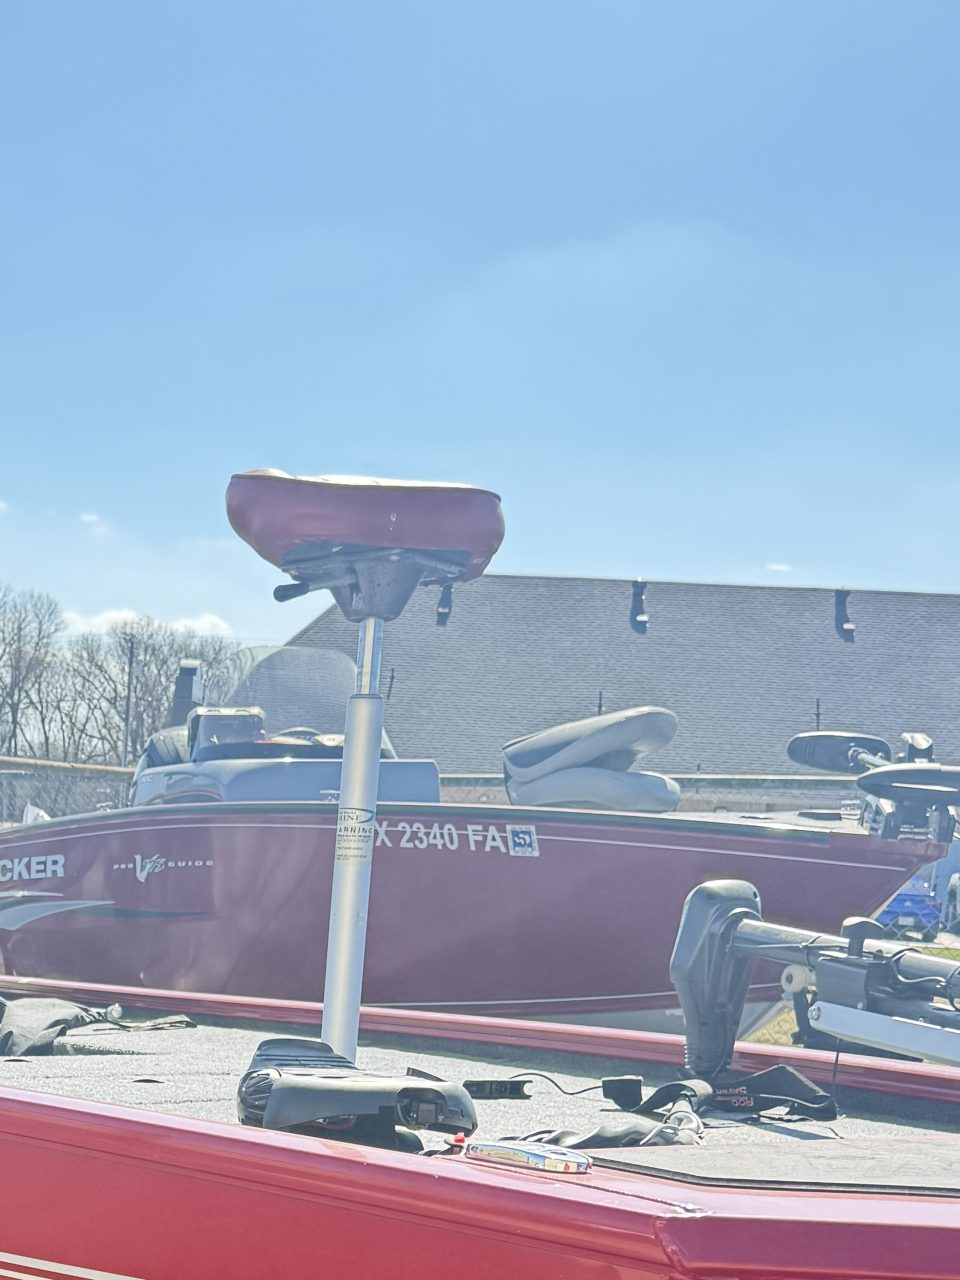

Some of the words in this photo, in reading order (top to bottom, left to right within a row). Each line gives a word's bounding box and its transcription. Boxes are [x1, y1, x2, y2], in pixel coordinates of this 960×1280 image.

[338, 826, 373, 834] ARNING
[374, 821, 393, 847] X
[397, 821, 459, 851] 2340
[467, 824, 508, 853] FA
